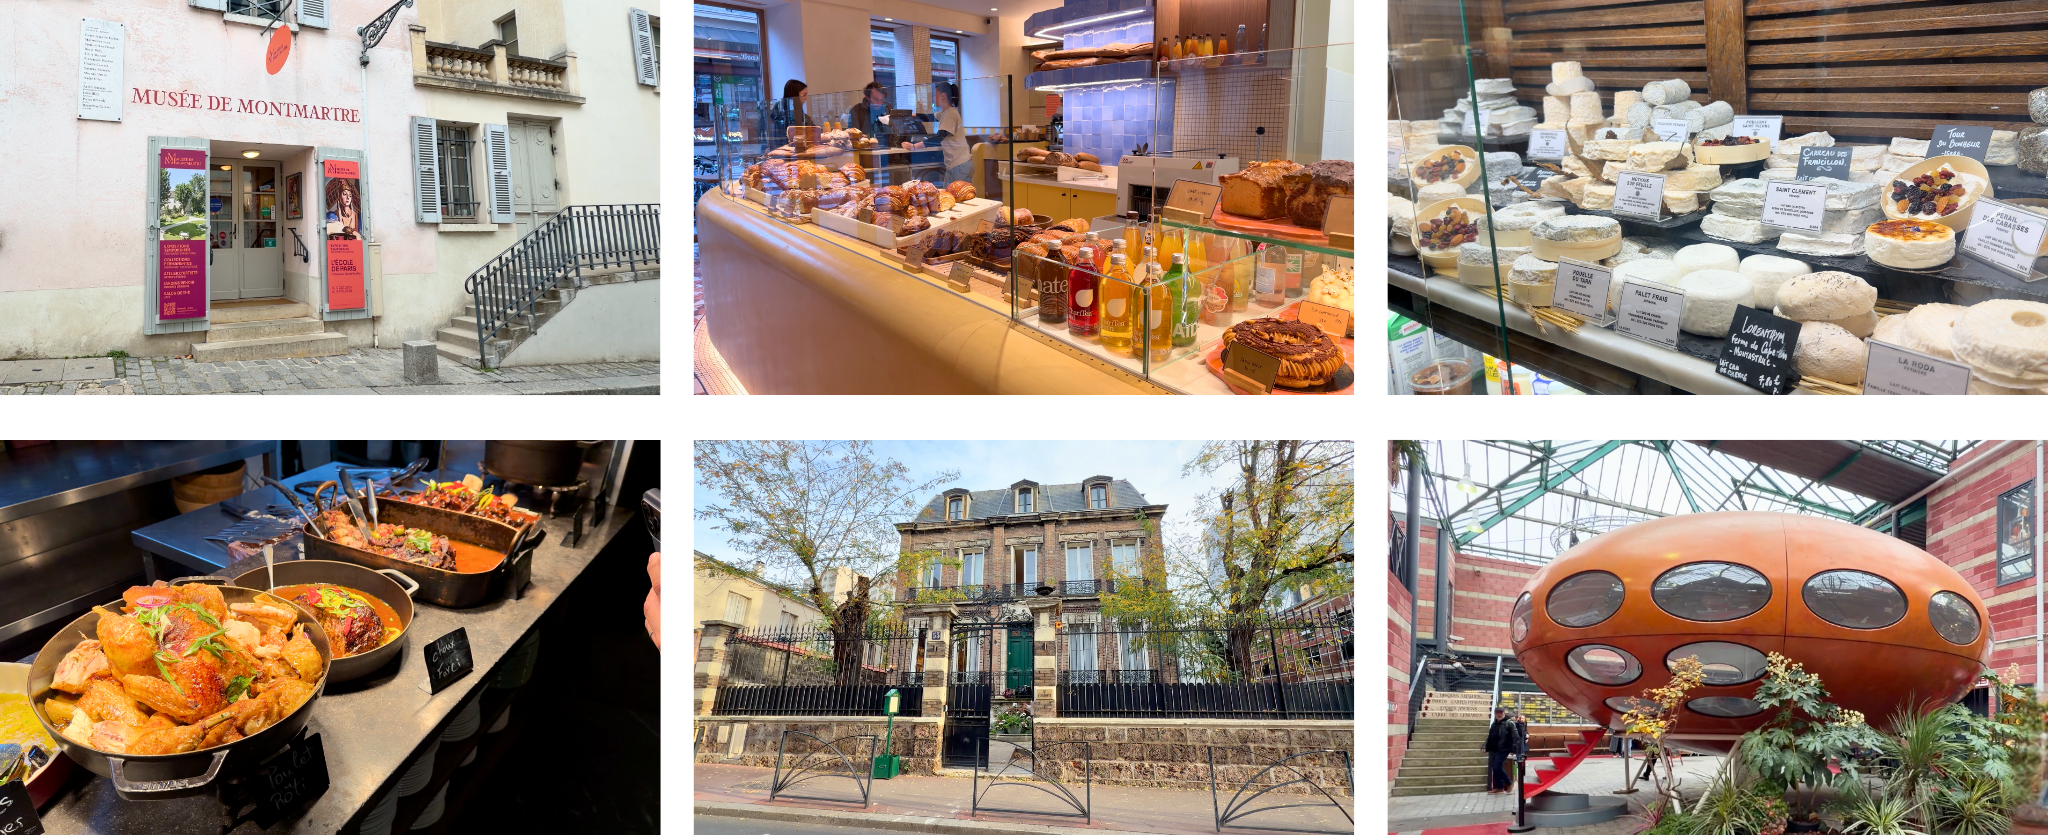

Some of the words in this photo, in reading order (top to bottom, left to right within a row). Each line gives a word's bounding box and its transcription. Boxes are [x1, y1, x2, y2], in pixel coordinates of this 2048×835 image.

[131, 88, 202, 109] MUSÉE
[207, 96, 232, 112] DE
[237, 98, 360, 122] MONTMARTRE
[1635, 290, 1651, 298] PALET
[1652, 294, 1668, 303] FRAIS
[1898, 357, 1908, 366] LA
[1912, 360, 1935, 373] RODA
